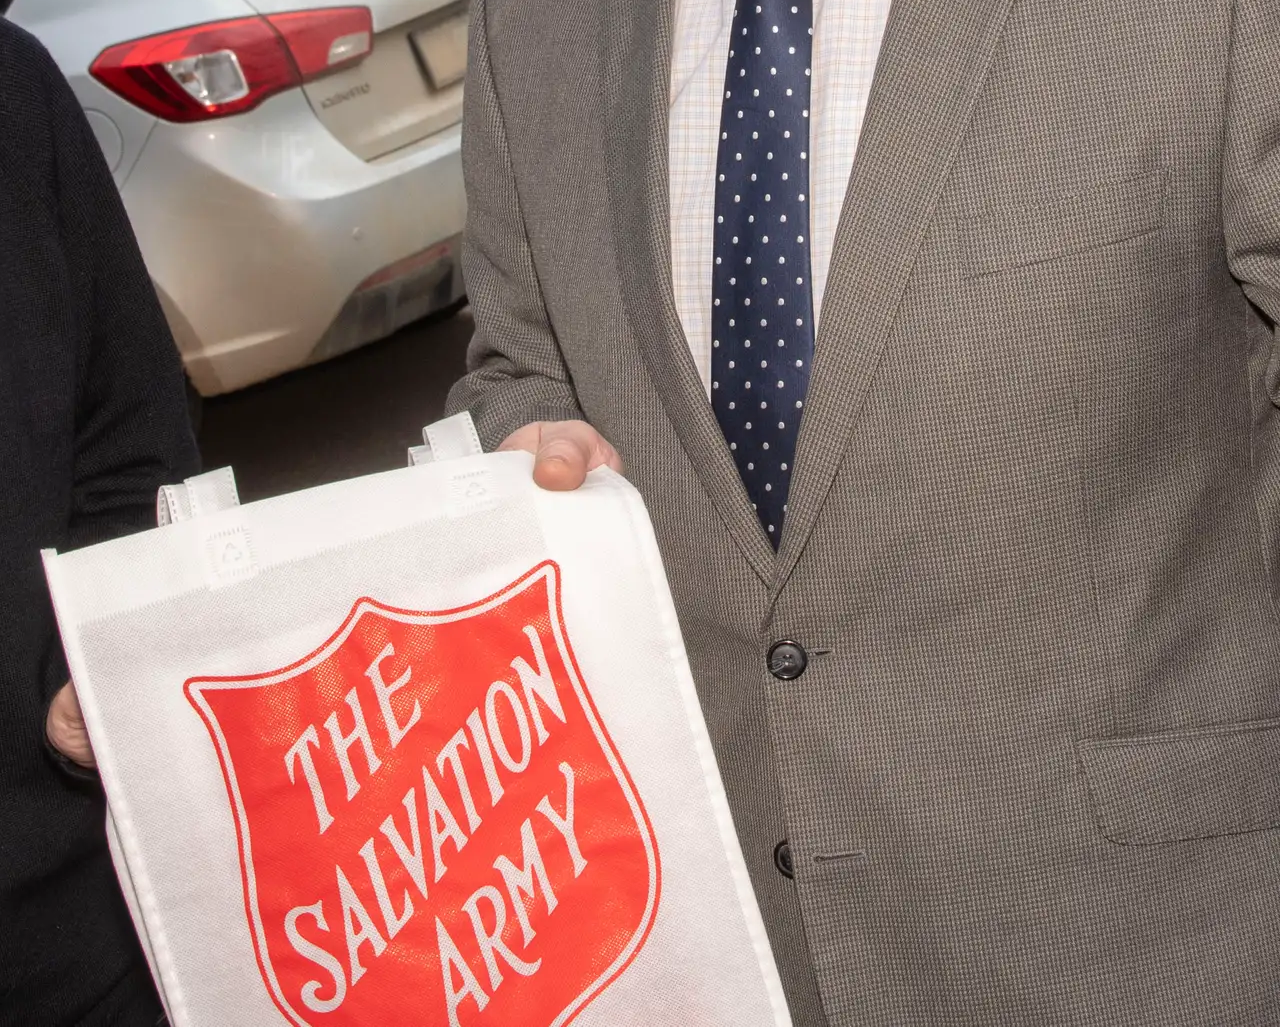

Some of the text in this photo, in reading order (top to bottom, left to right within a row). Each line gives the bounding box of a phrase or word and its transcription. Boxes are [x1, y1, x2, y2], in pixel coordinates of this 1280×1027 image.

[284, 642, 421, 834] THE
[284, 625, 567, 1013] SALVATION
[434, 761, 588, 1027] ARMY
